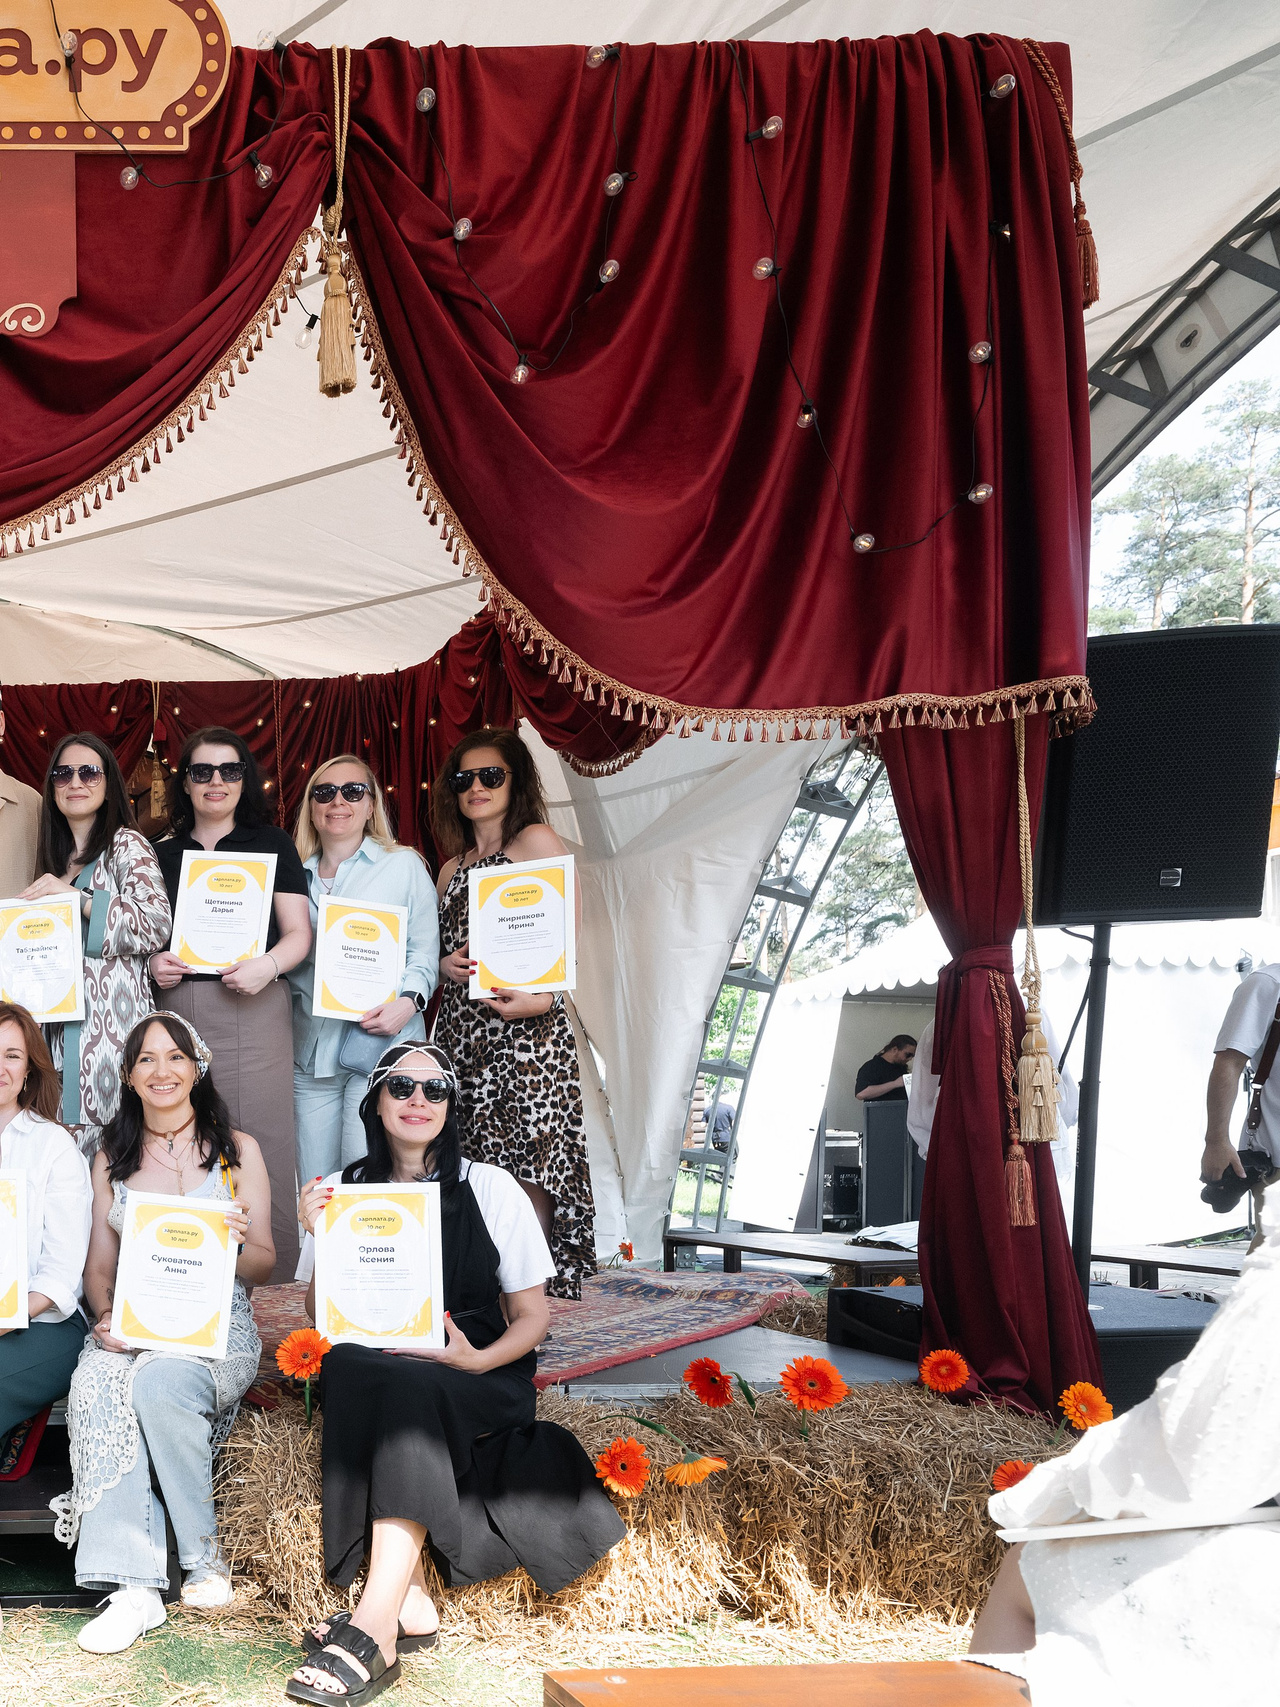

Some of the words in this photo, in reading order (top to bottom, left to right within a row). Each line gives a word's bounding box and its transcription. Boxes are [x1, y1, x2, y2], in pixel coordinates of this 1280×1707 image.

[498, 912, 545, 923] Жирнякова
[508, 921, 535, 930] Ирина
[341, 945, 380, 955] Шестакова
[344, 952, 376, 962] Светлана
[164, 1228, 198, 1237] зарплата.ру
[359, 1246, 395, 1254] Орлова
[151, 1254, 202, 1266] Суковатова
[164, 1266, 187, 1274] Анна
